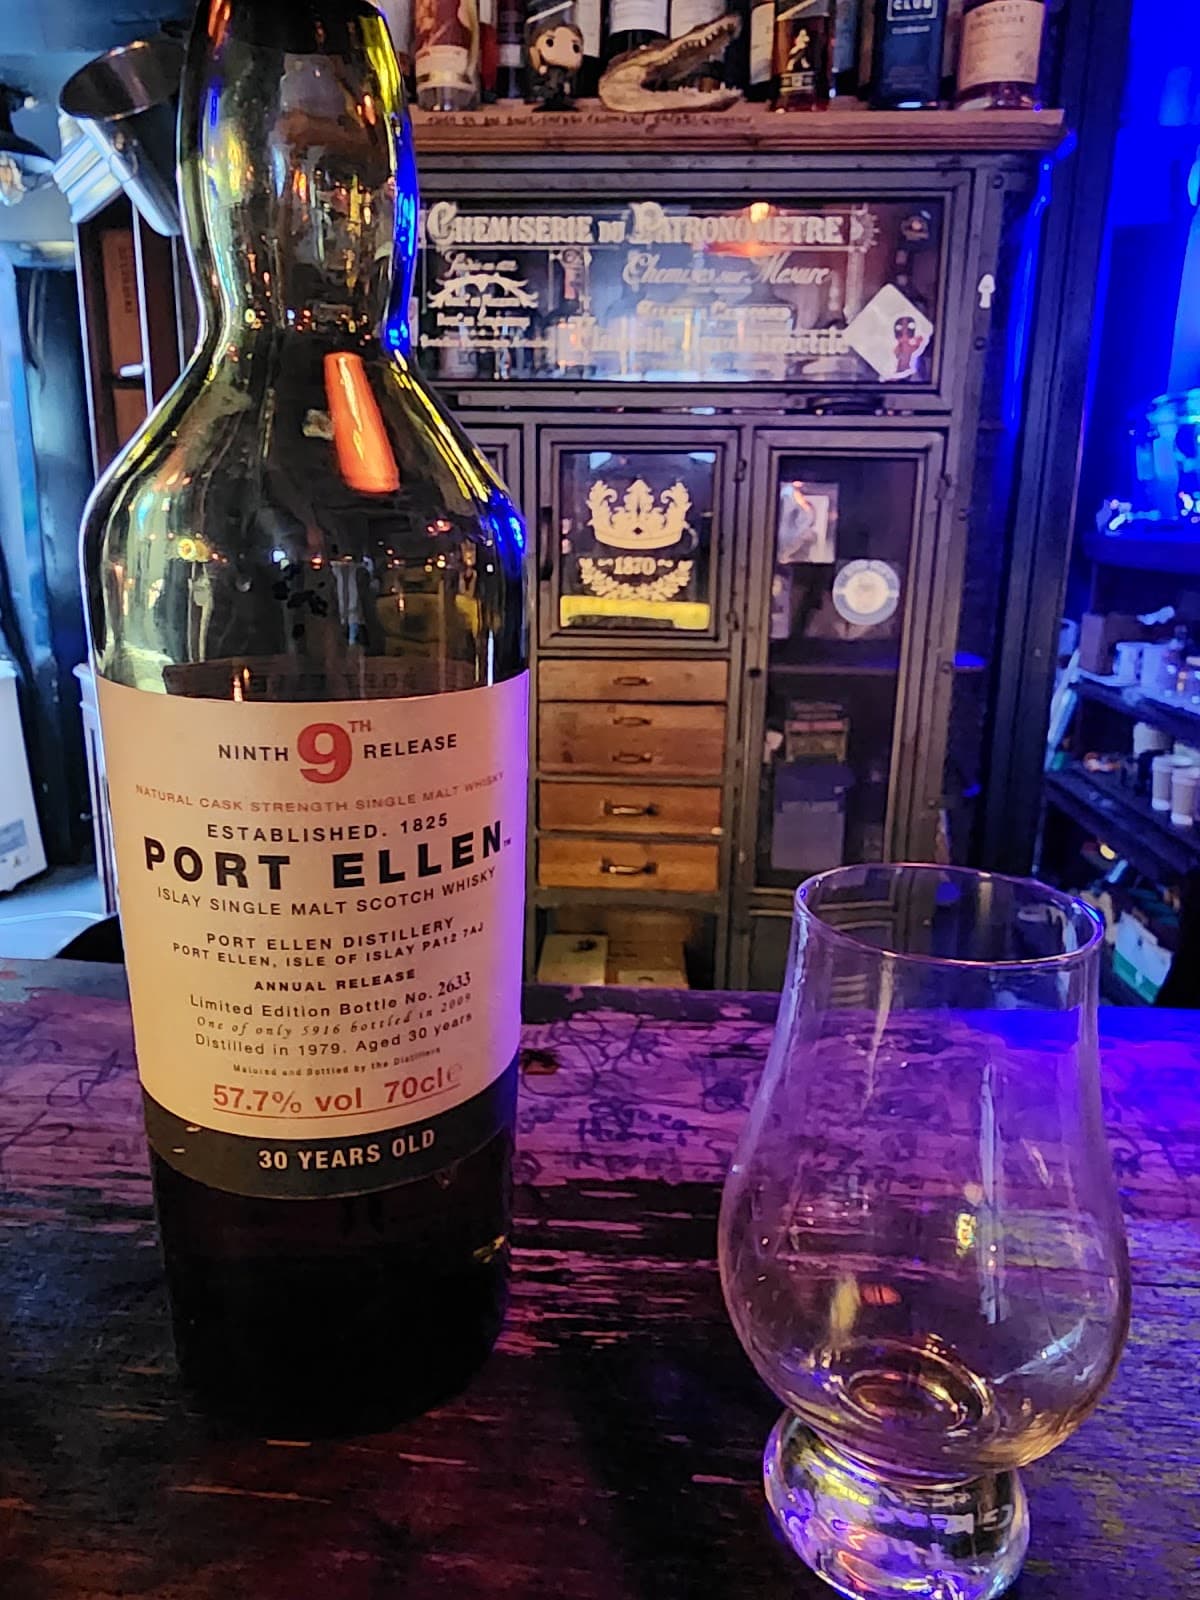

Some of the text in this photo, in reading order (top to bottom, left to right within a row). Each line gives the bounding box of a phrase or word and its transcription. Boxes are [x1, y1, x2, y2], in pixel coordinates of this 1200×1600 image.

[218, 744, 289, 761] NINTH
[363, 733, 457, 759] RELEASE
[135, 771, 505, 813] NATURAL CASK STRENGTH SINGLE MALT WHISKY
[207, 812, 448, 843] ESTABLISHED. 1825
[144, 820, 501, 891] PORT ELLEN
[158, 866, 496, 916] ISLAY SINGLE MALT SCOTCH WHISKY
[173, 942, 210, 960] PORT
[217, 952, 278, 968] ELLEN,
[286, 956, 326, 967] ISLE
[335, 953, 358, 966] OF
[366, 943, 415, 963] ISLAY
[463, 921, 485, 939] 7AJ
[206, 916, 454, 951] PORT ELLEN DISTILLERY
[190, 970, 471, 1018] Limited Edition Bottle No. 2633
[254, 968, 416, 992] ANNUAL RELEASE
[195, 1012, 472, 1057] Distilled in 1979. Aged 30 years
[197, 1015, 223, 1030] One
[231, 1022, 249, 1037] of
[256, 1024, 292, 1040] only
[301, 1023, 340, 1036] 5916
[213, 1083, 302, 1114] 57.7%
[314, 1087, 363, 1112] vol
[258, 1129, 435, 1171] 30 YEARS OLD
